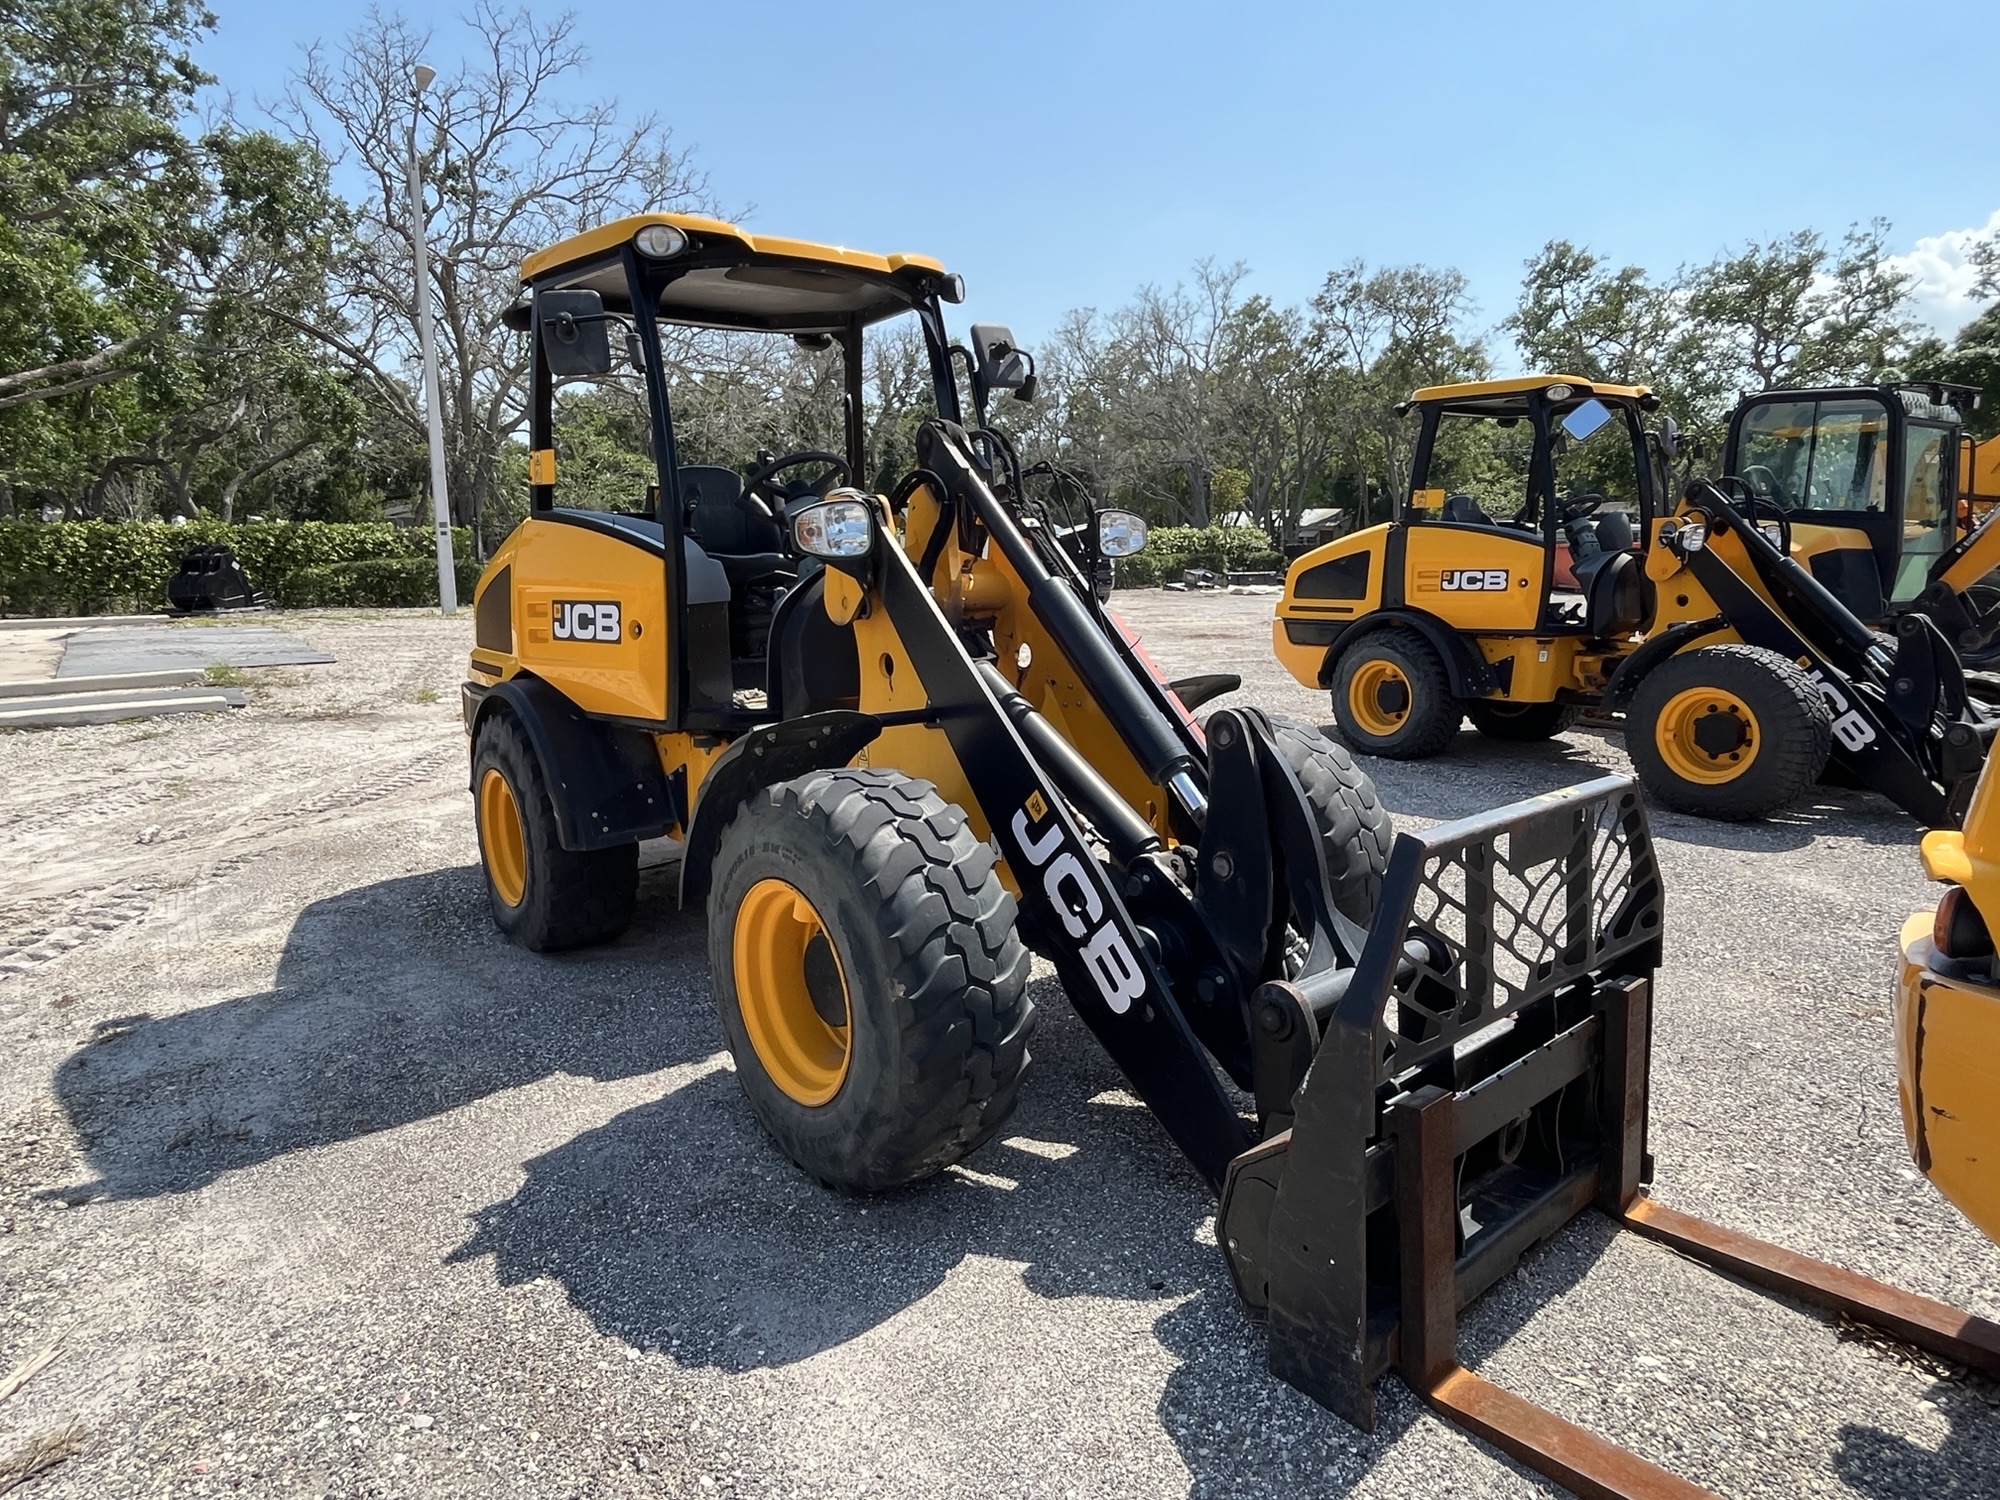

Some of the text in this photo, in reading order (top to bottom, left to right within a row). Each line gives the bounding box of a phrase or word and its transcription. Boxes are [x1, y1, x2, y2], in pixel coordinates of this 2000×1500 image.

[1442, 571, 1507, 590] JCB
[553, 604, 620, 641] JCB
[1012, 808, 1146, 1014] JCB
